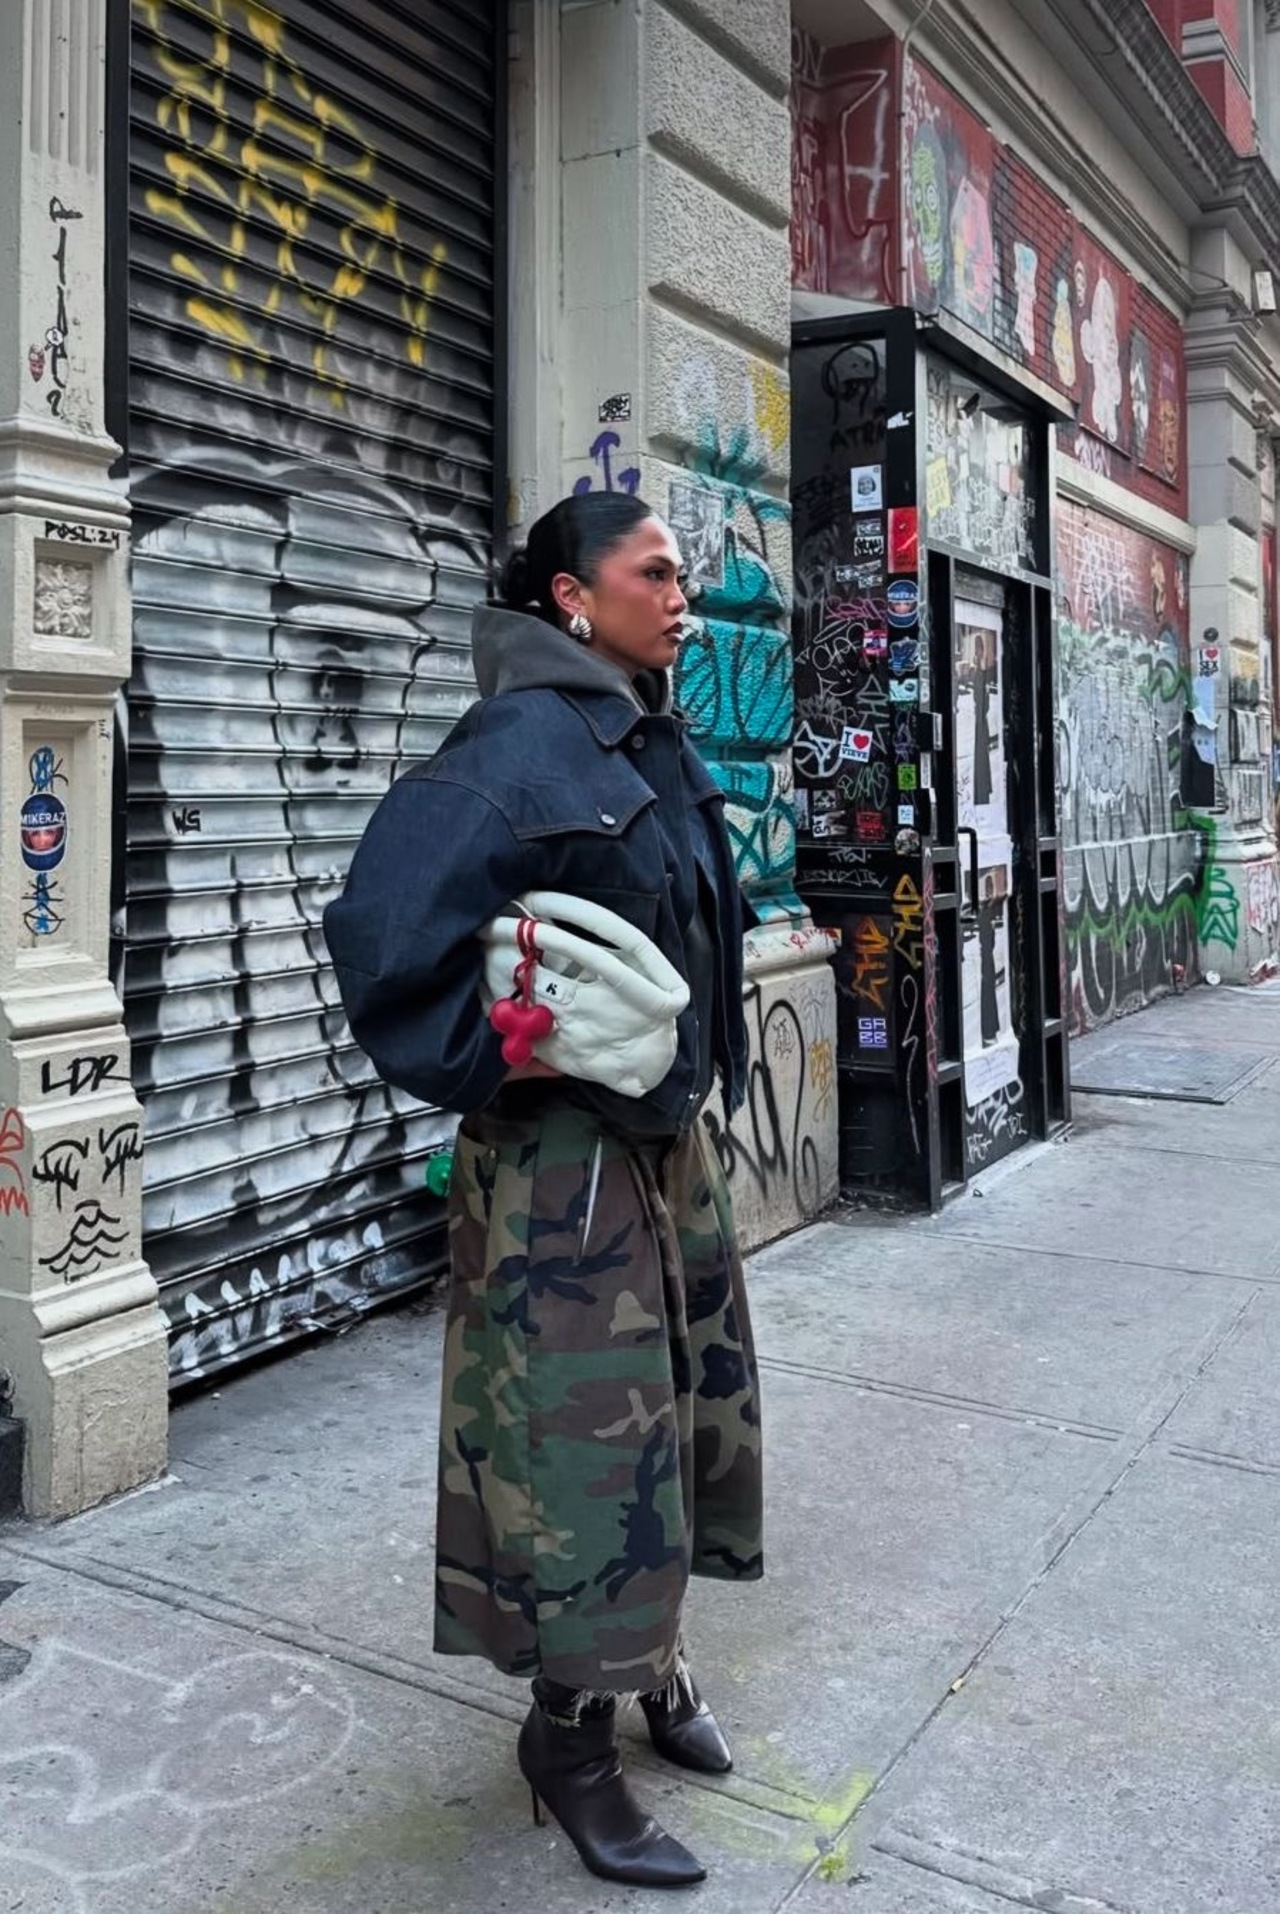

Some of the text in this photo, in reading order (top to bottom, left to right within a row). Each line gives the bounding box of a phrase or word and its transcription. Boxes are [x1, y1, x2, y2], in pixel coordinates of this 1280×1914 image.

[843, 731, 853, 748] I
[21, 811, 66, 826] MIKERAZ
[41, 1054, 132, 1097] LDR
